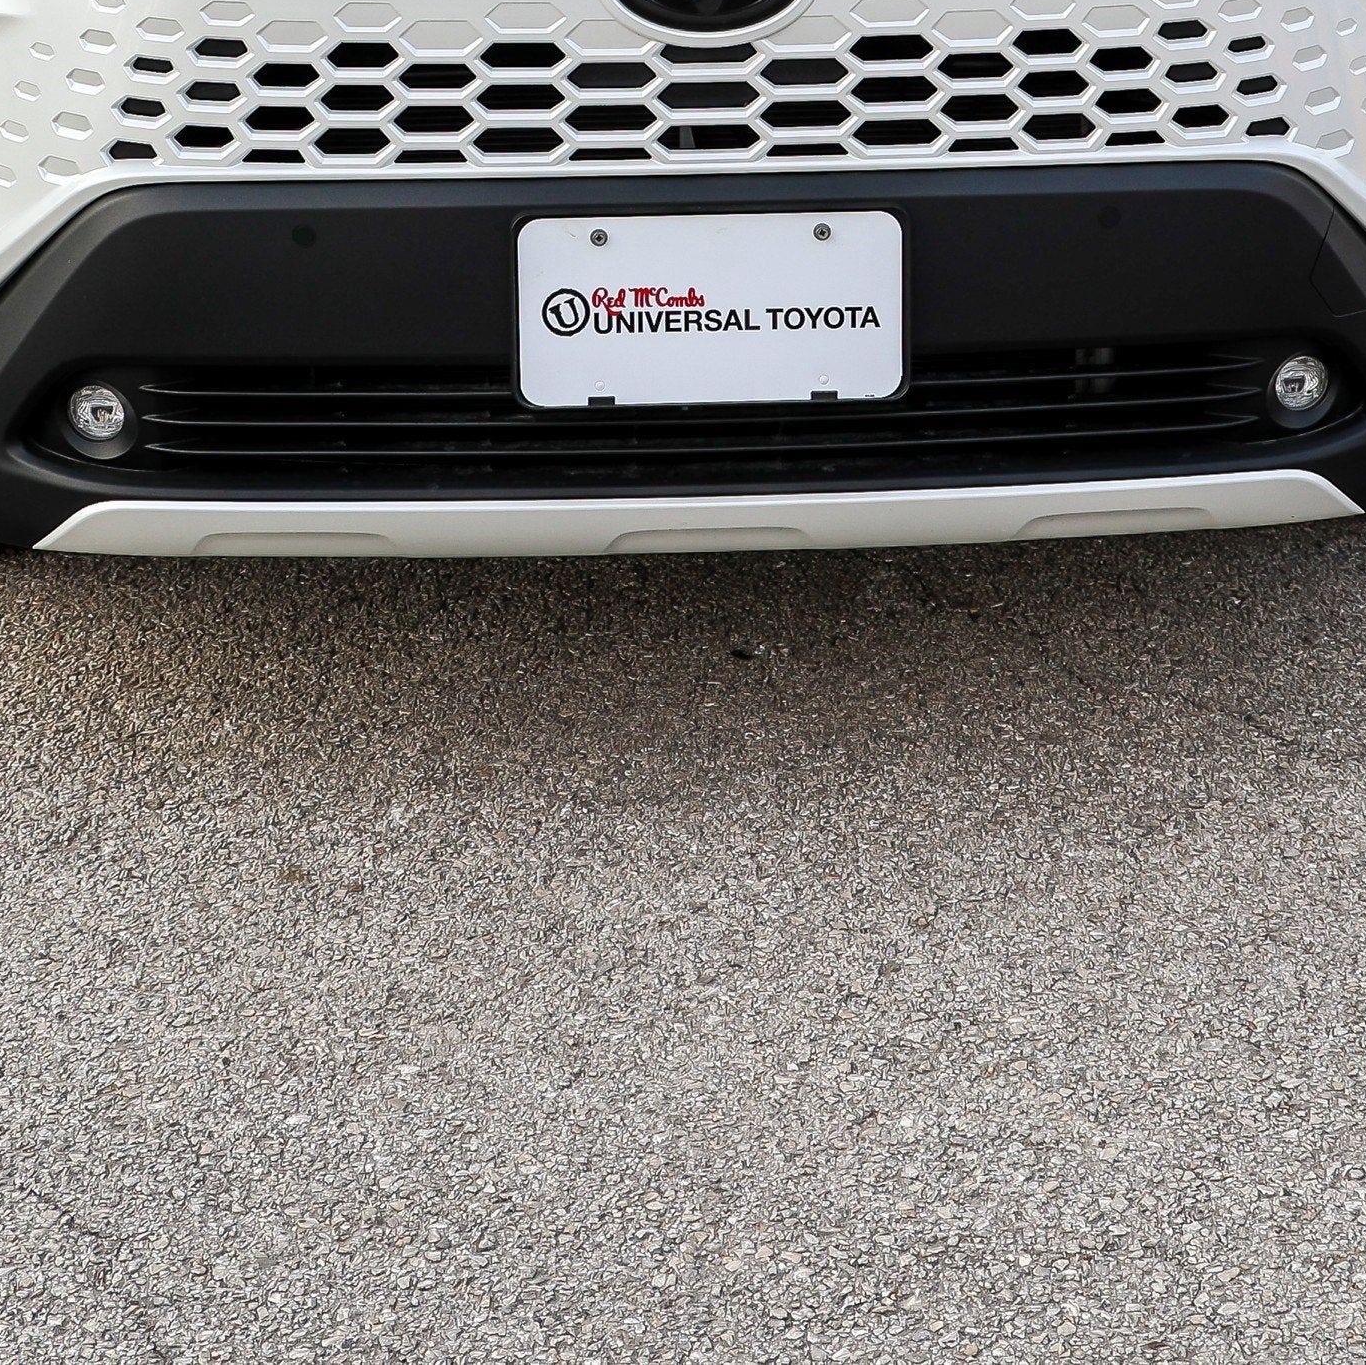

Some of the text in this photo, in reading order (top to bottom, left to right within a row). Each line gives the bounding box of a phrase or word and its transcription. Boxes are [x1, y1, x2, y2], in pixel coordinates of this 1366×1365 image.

[591, 286, 705, 317] Red McCombs
[593, 306, 881, 335] UNIVERSAL TOYOTA
